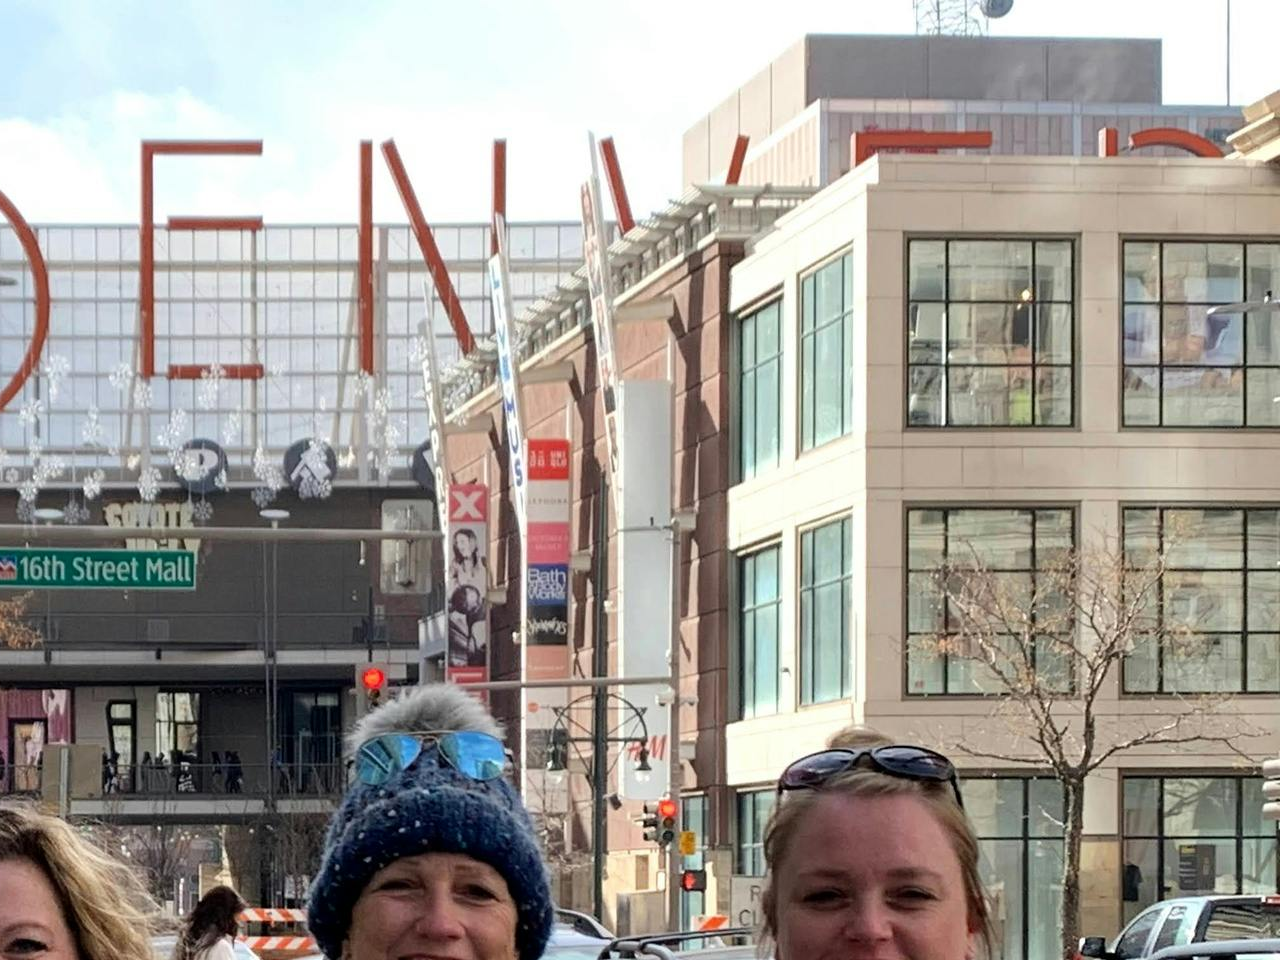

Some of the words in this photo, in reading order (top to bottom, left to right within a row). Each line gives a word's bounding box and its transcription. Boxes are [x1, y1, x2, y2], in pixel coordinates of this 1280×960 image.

[20, 554, 66, 581] 16th
[72, 556, 139, 582] Street
[146, 556, 192, 582] Mall
[527, 568, 567, 584] Bath
[628, 735, 669, 762] HM
